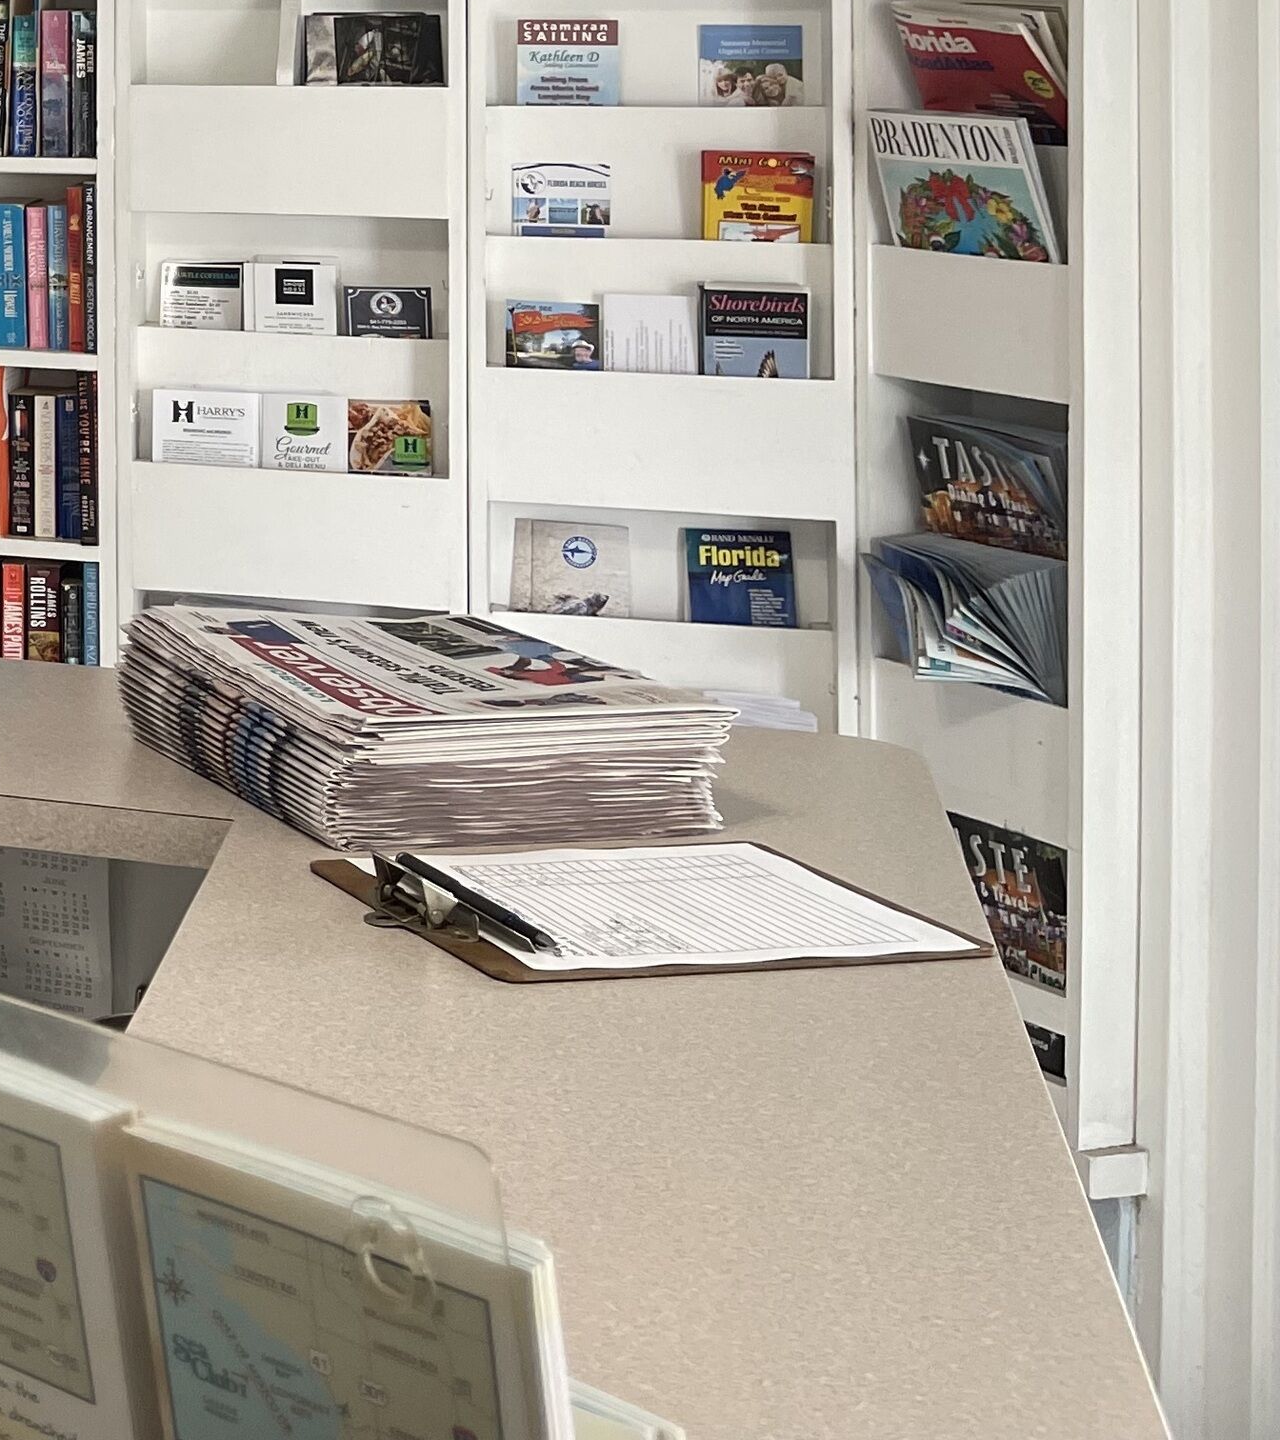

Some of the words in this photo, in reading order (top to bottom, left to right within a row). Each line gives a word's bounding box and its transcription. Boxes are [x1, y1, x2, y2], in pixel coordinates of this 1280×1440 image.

[523, 21, 608, 31] Catamaran
[523, 31, 608, 42] SAILING
[76, 38, 86, 79] JAMES
[529, 50, 585, 64] Kathleen
[587, 52, 600, 62] D
[870, 117, 1008, 163] BRADENTON
[709, 294, 805, 314] Shorebirds
[711, 315, 724, 323] OF
[726, 316, 760, 324] NORTH
[762, 317, 803, 325] AMERICA
[197, 406, 245, 417] HARRY'S
[275, 436, 332, 460] Gourmet
[711, 534, 733, 542] RAND
[699, 545, 781, 567] Florida
[711, 570, 732, 585] Map
[30, 576, 46, 628] ROLLINS
[47, 588, 56, 619] JAMES
[419, 664, 503, 692] reasons
[992, 884, 1029, 911] Travel
